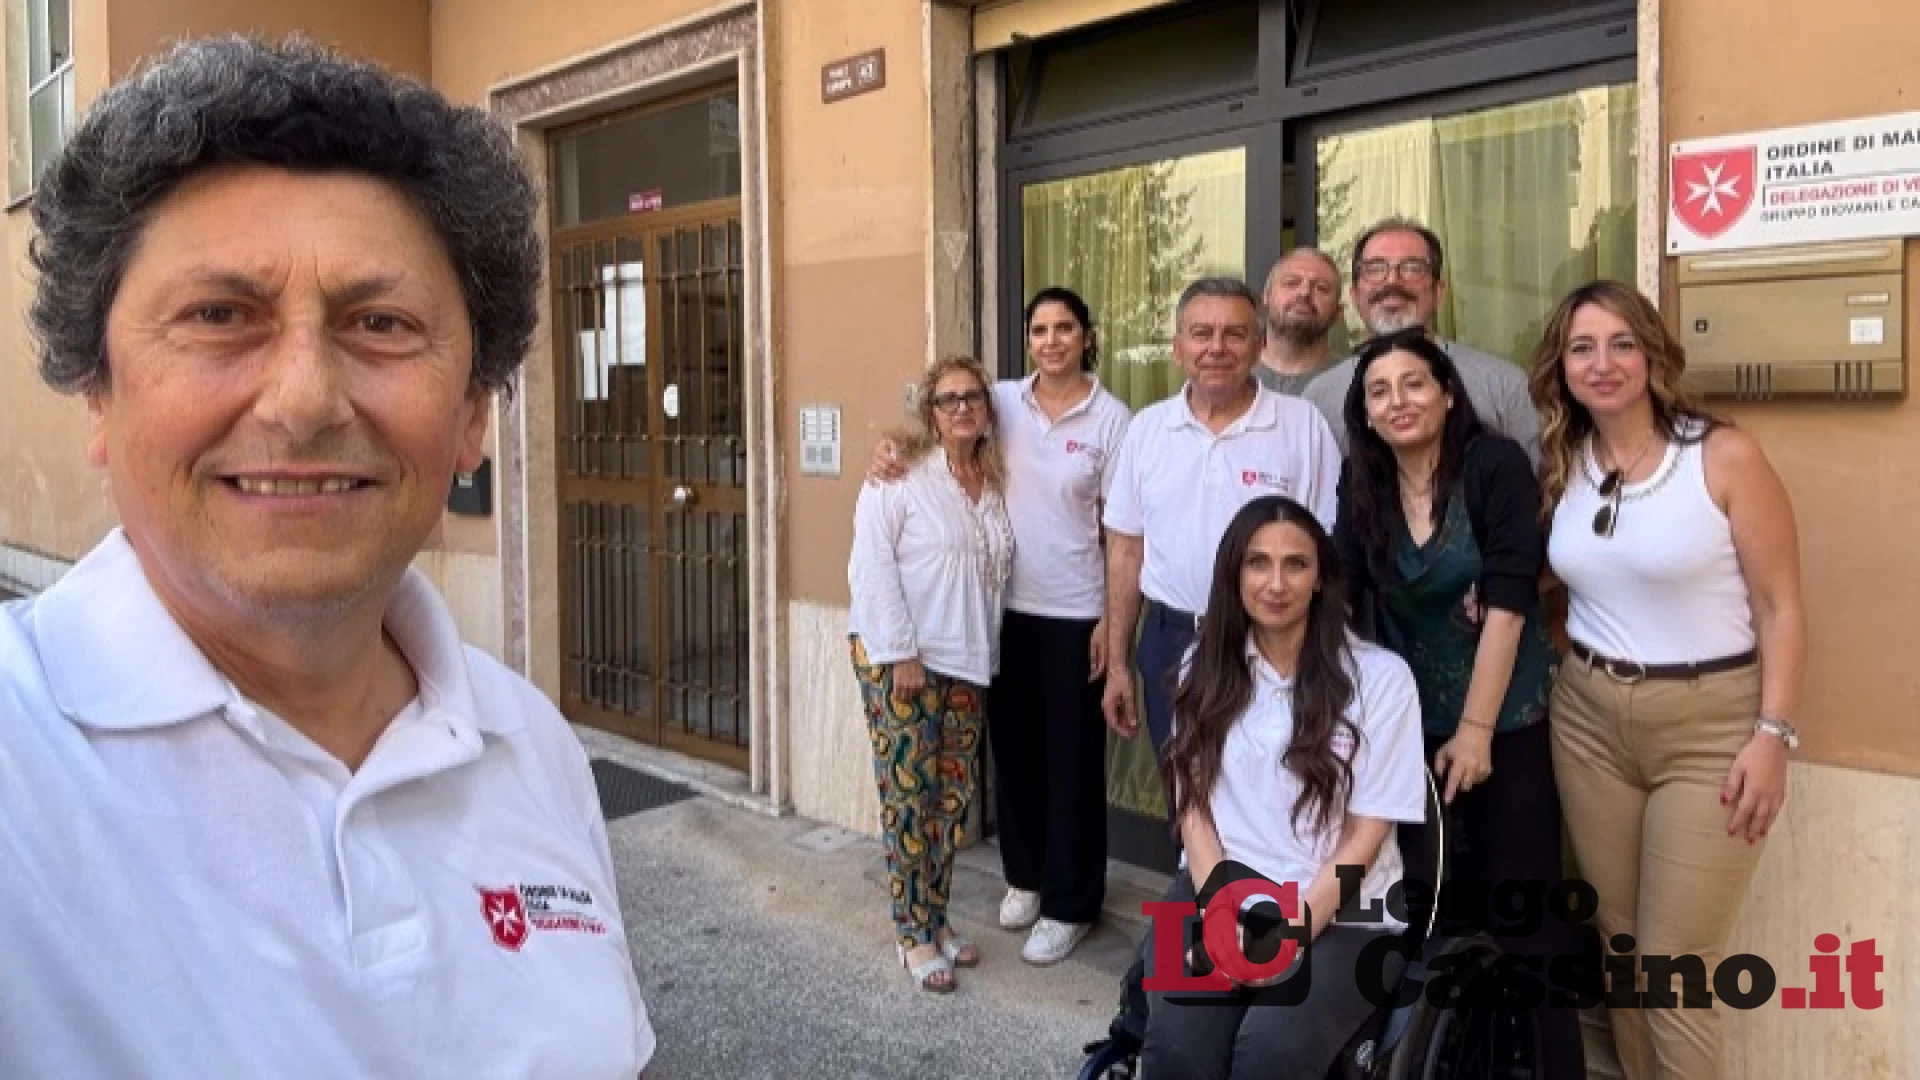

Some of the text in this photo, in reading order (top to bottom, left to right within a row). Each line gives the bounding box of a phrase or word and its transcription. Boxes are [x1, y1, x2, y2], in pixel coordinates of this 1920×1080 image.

[1767, 138, 1846, 160] ORDINE
[1853, 135, 1875, 151] DI
[1766, 159, 1833, 181] ITALIA
[1770, 182, 1877, 205] DELEGAZIONE
[1882, 178, 1899, 195] DI
[1821, 200, 1896, 216] GIOVANILE
